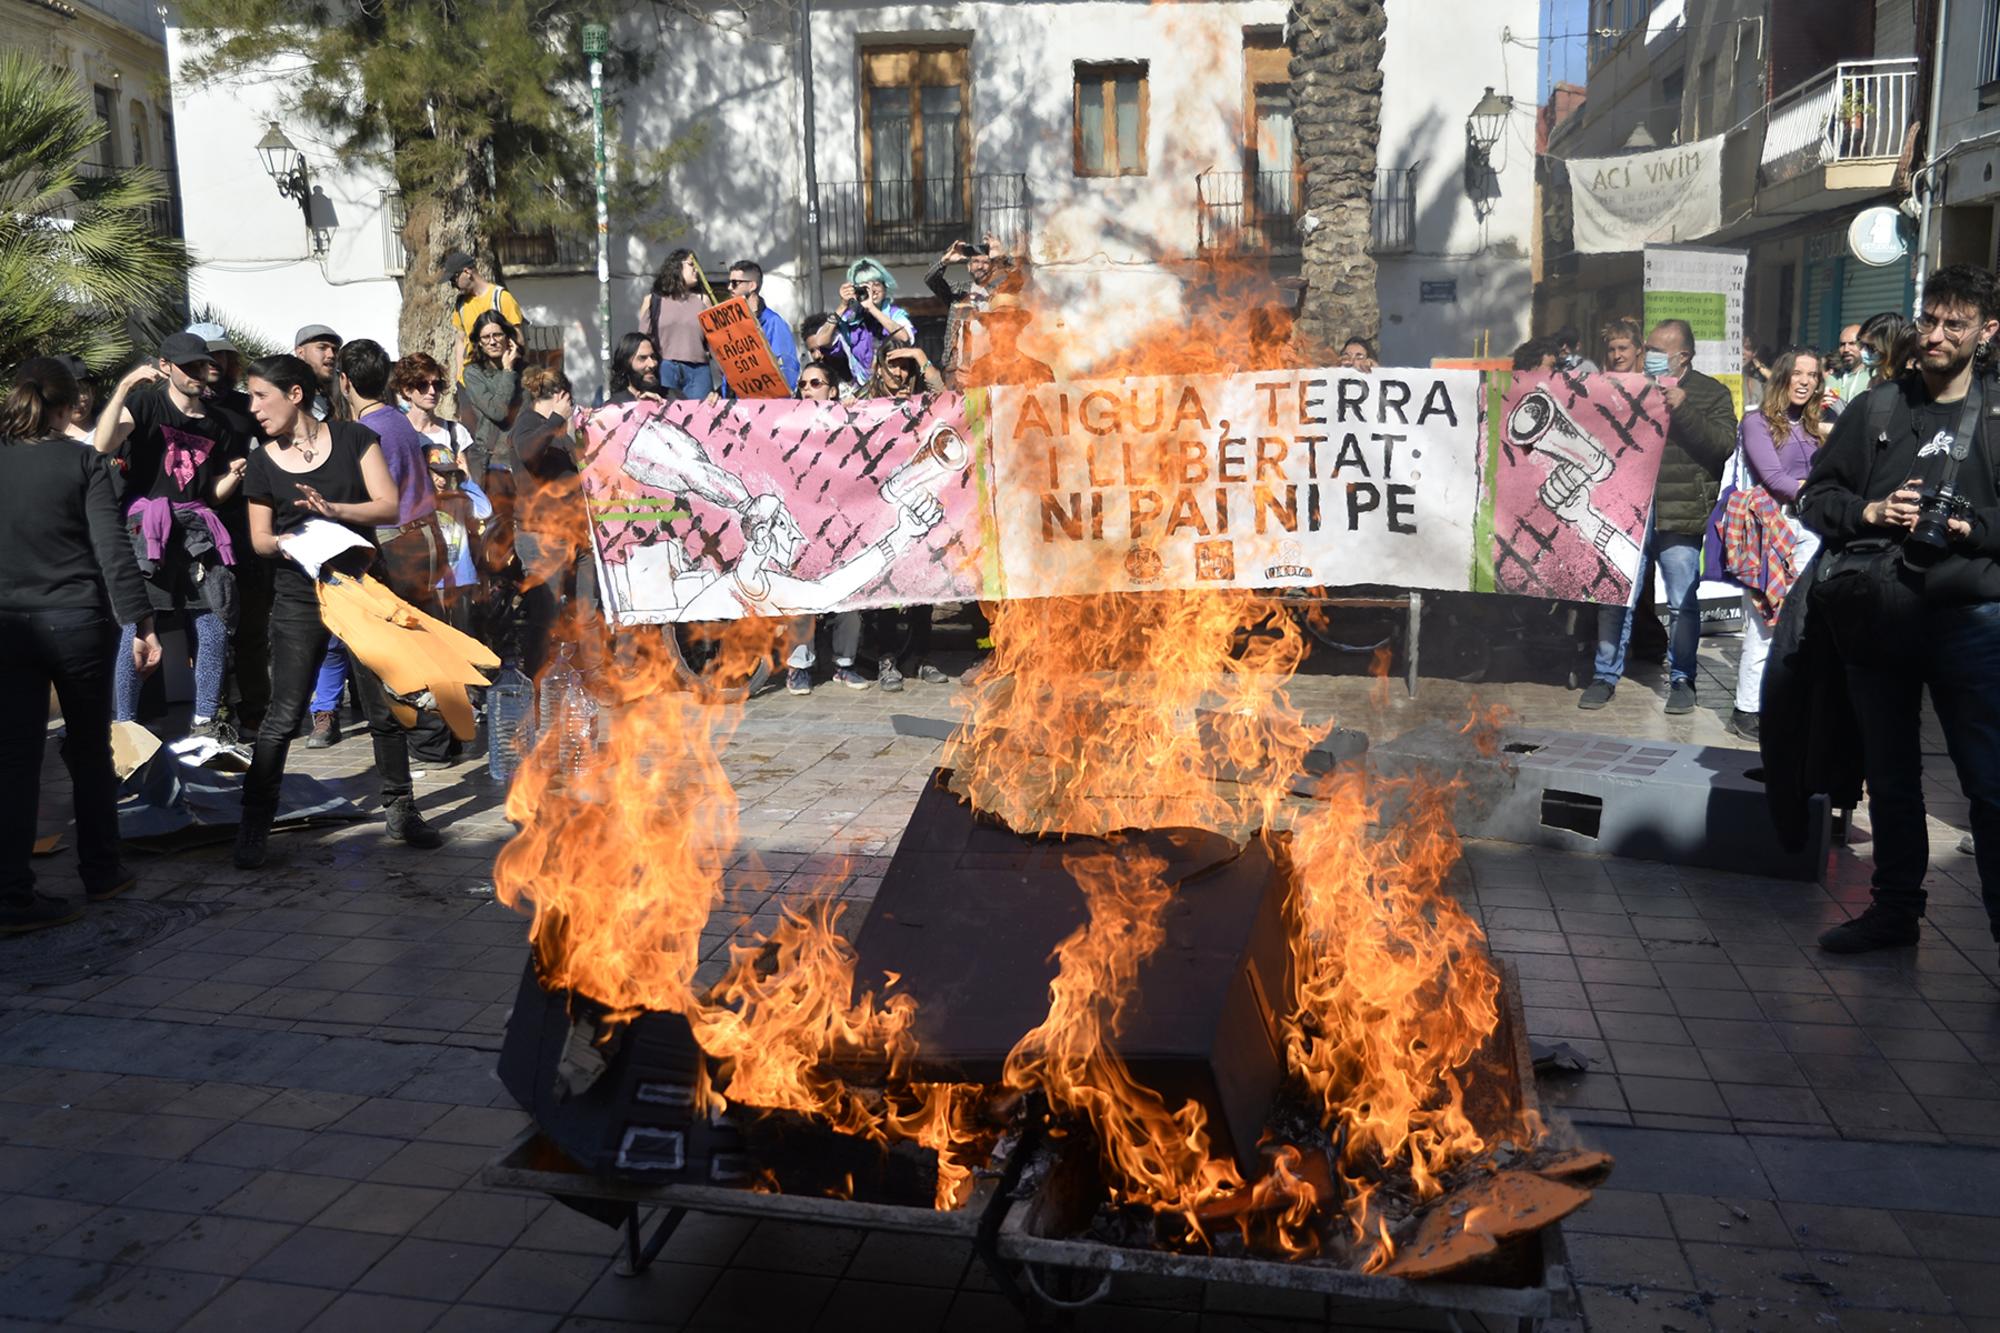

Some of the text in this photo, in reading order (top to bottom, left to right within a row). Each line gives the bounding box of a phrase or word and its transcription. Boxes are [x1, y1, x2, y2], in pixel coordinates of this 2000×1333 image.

[1592, 160, 1632, 191] ACÍ
[1012, 378, 1458, 440] AIGUA, TERRA
[1048, 432, 1423, 490] I LLIBERTAT:
[1039, 481, 1419, 544] NI PAI NI PE
